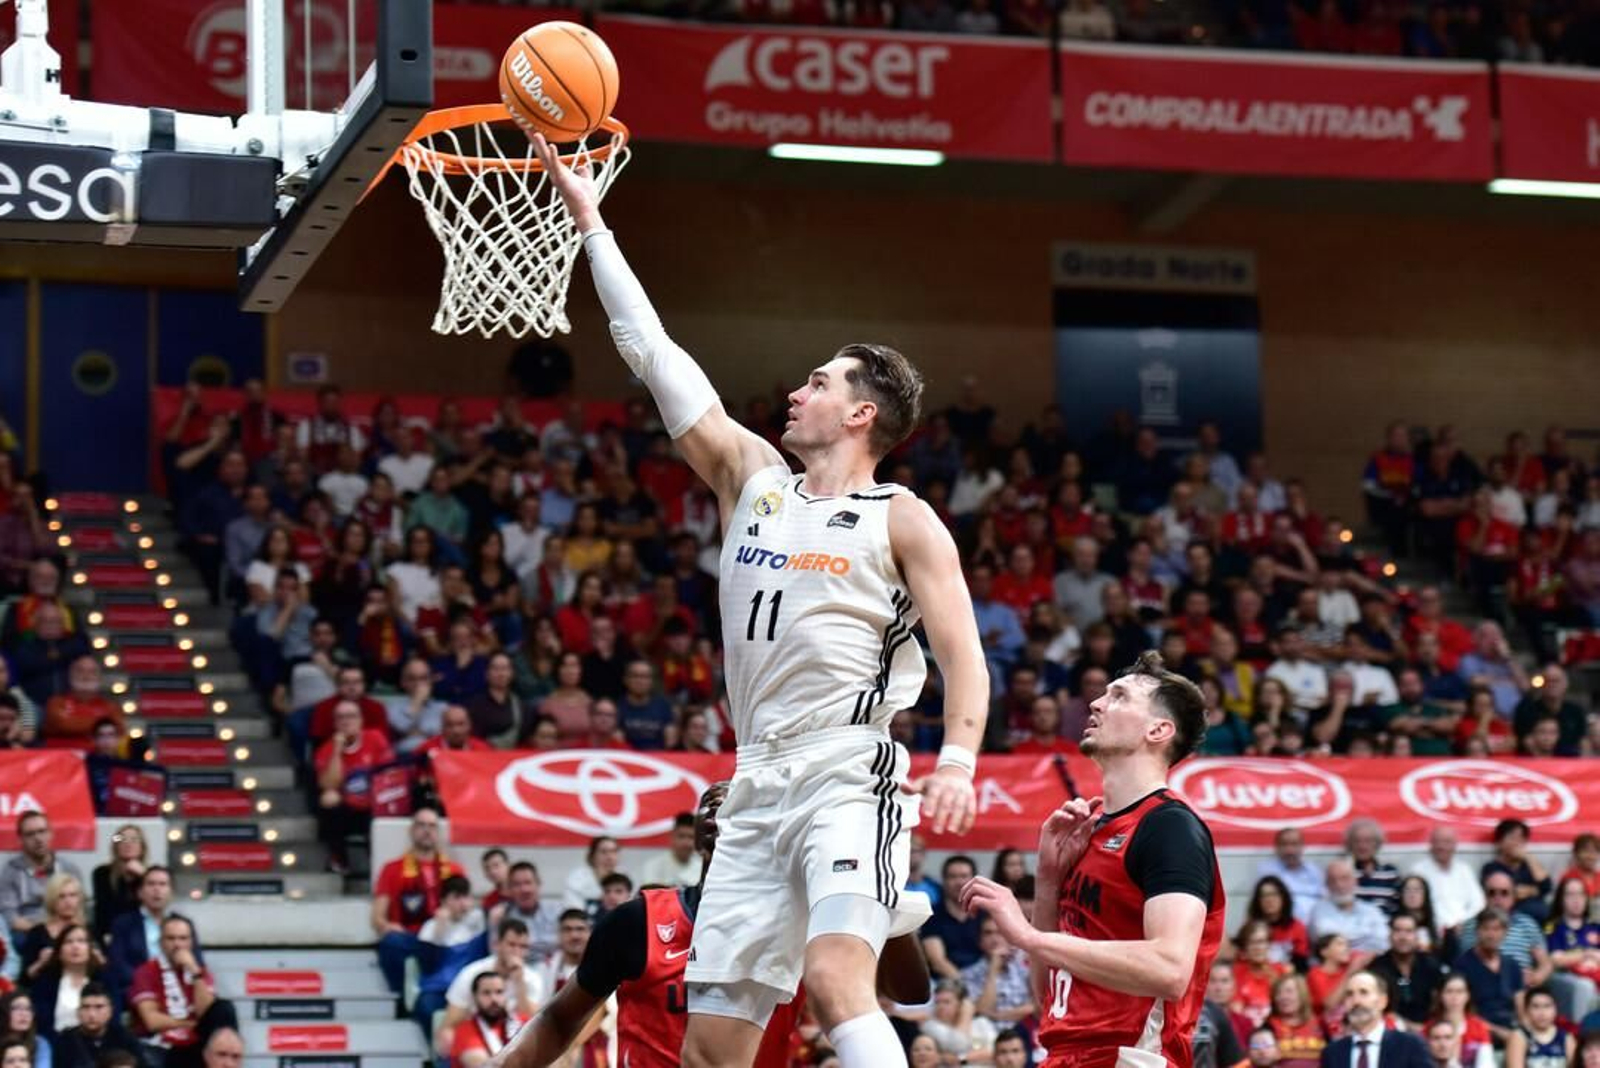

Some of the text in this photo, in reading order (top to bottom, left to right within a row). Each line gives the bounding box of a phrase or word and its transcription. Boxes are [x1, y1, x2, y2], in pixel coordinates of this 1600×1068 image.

[510, 50, 565, 123] Wilson
[755, 37, 949, 98] caser
[705, 102, 953, 142] Grupo Helvetia
[1084, 93, 1414, 140] COMPRALAENTRADA
[734, 545, 850, 577] AUTOHERO
[747, 589, 783, 641] 11
[1198, 775, 1325, 809] Juver
[1426, 781, 1553, 812] Juver
